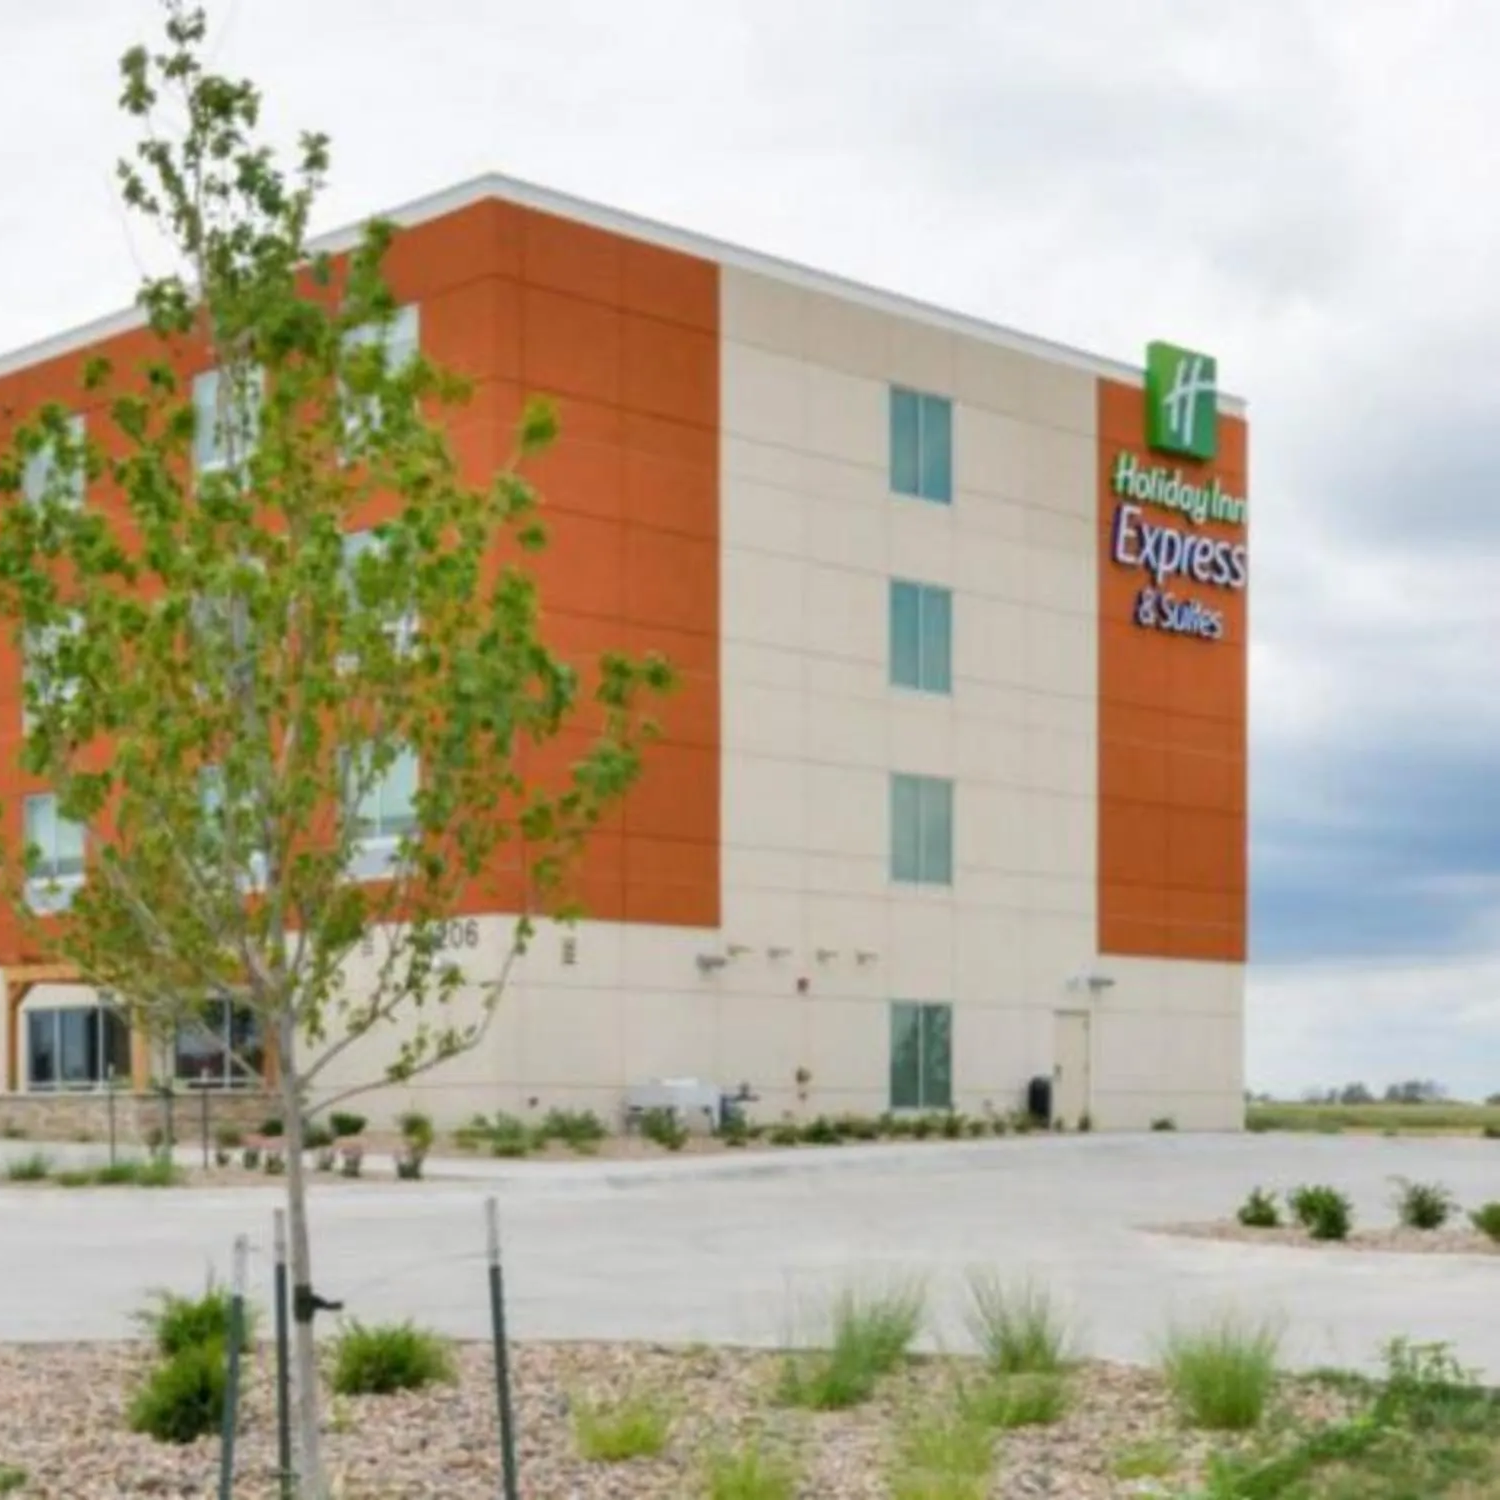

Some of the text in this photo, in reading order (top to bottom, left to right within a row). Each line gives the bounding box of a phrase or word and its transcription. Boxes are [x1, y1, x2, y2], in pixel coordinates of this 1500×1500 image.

[1113, 451, 1247, 525] Holiday Inn
[1113, 501, 1247, 589] Express
[1136, 586, 1224, 639] & Suites
